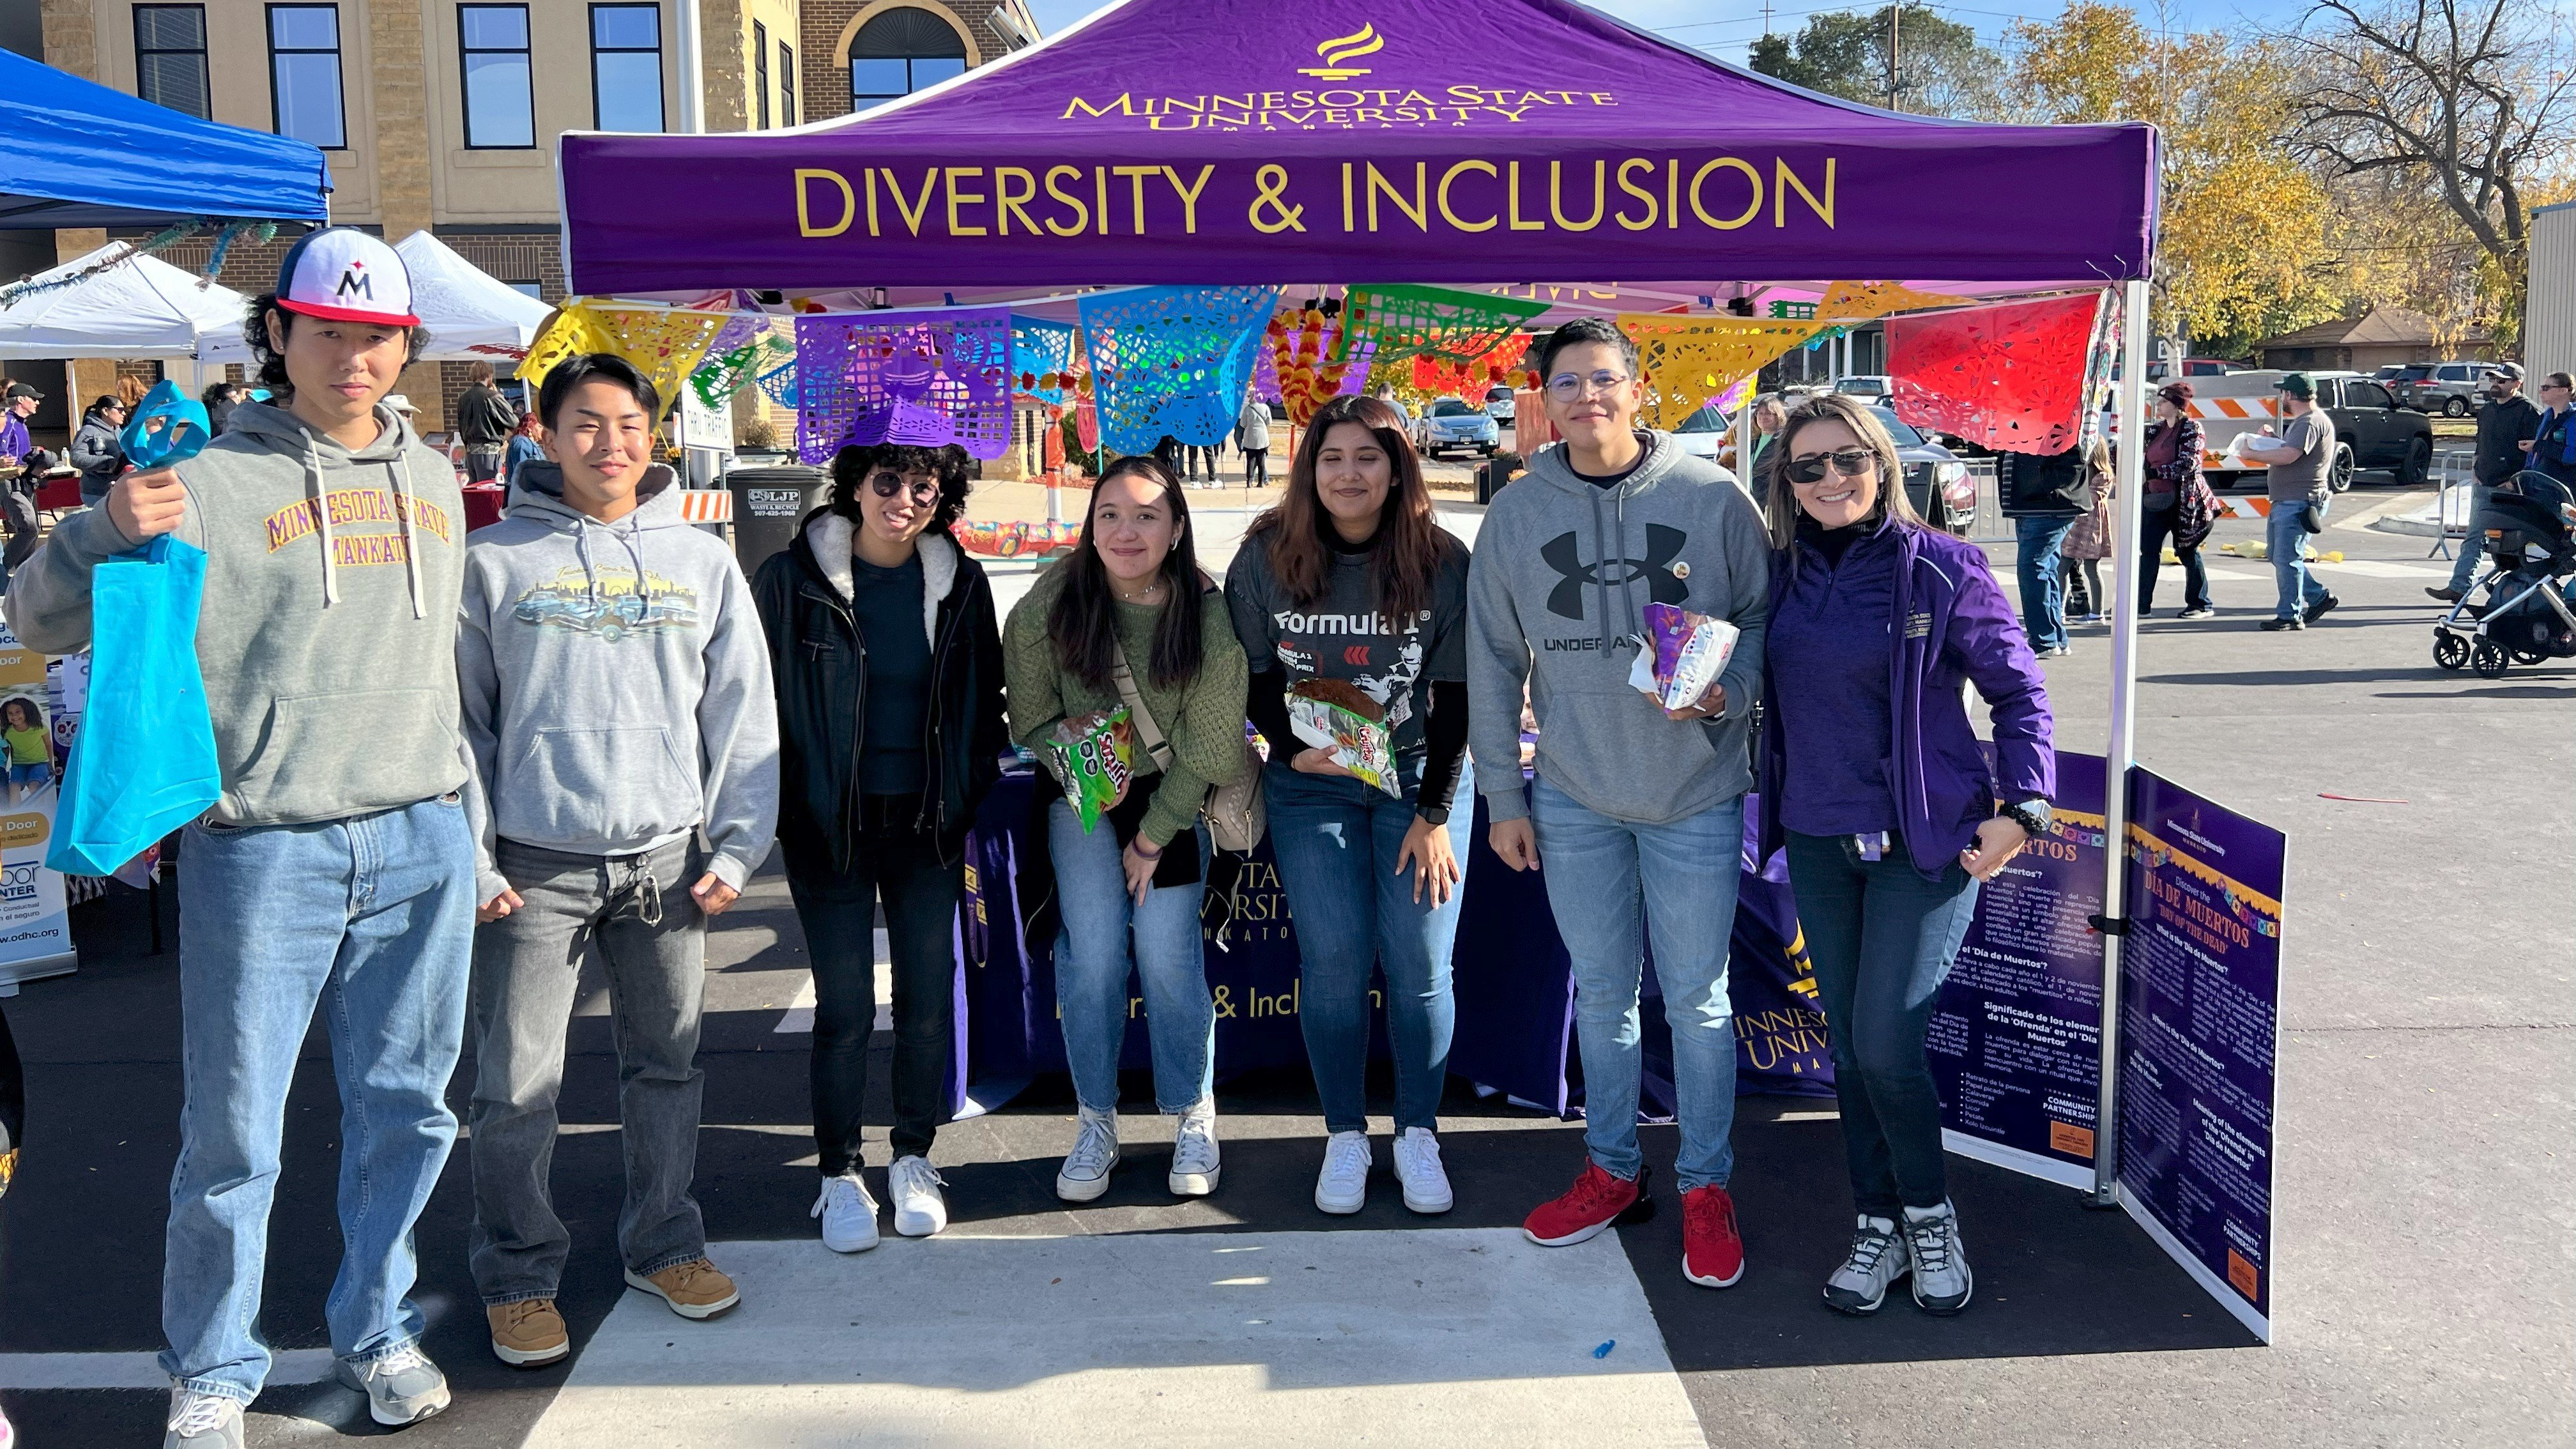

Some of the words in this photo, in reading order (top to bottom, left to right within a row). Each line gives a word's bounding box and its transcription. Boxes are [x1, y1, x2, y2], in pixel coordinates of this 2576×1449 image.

[1058, 89, 1437, 120] MINNESOTA
[1448, 84, 1619, 107] STATE
[1149, 105, 1535, 131] UNIVERSITY
[794, 164, 1216, 238] DIVERSITY
[1248, 163, 1308, 234] &
[1342, 156, 1837, 233] INCLUSION
[336, 270, 374, 301] M
[769, 491, 799, 501] LJP
[263, 488, 395, 555] MINNESOTA
[1274, 610, 1398, 636] Formula
[6, 820, 38, 831] Door
[2175, 876, 2200, 897] Discover
[2200, 891, 2211, 904] the
[14, 910, 40, 921] seguro
[2145, 871, 2164, 899] DÍA
[2166, 882, 2181, 910] DE
[2186, 894, 2251, 949] MUERTOS
[1962, 946, 1971, 954] el
[1972, 947, 1989, 958] 'Día
[1990, 951, 2002, 961] de
[2004, 954, 2048, 970] Muertos'?
[1214, 985, 1237, 1018] &
[1984, 1001, 2035, 1020] Significado
[2035, 1013, 2048, 1023] de
[2050, 1016, 2064, 1026] los
[1987, 1012, 1999, 1022] de
[2000, 1015, 2009, 1024] la
[2011, 1017, 2053, 1034] 'Ofrenda'
[2054, 1029, 2067, 1037] en
[2067, 1031, 2077, 1039] el
[2078, 1032, 2097, 1044] 'Día
[2027, 1031, 2068, 1047] Muertos'
[1965, 1080, 1983, 1090] Papel
[1983, 1086, 2005, 1096] picado
[1965, 1087, 1995, 1101] Calaveras
[1966, 1072, 1989, 1084] Retrato
[2005, 1084, 2031, 1094] persona
[1965, 1096, 1989, 1108] Comida
[2043, 1102, 2096, 1121] PARTNERSHIP
[2048, 1096, 2096, 1114] COMMUNITY
[2193, 1097, 2218, 1124] Meaning
[2225, 1121, 2235, 1136] the
[2235, 1131, 2266, 1158] elements
[2208, 1122, 2219, 1136] the
[2218, 1130, 2247, 1156] 'Ofrenda'
[2204, 1130, 2216, 1146] 'Día
[2224, 1145, 2251, 1171] Muertos'
[2223, 1225, 2262, 1261] PARTNERSHIPS
[2226, 1218, 2259, 1248] COMMUNITY
